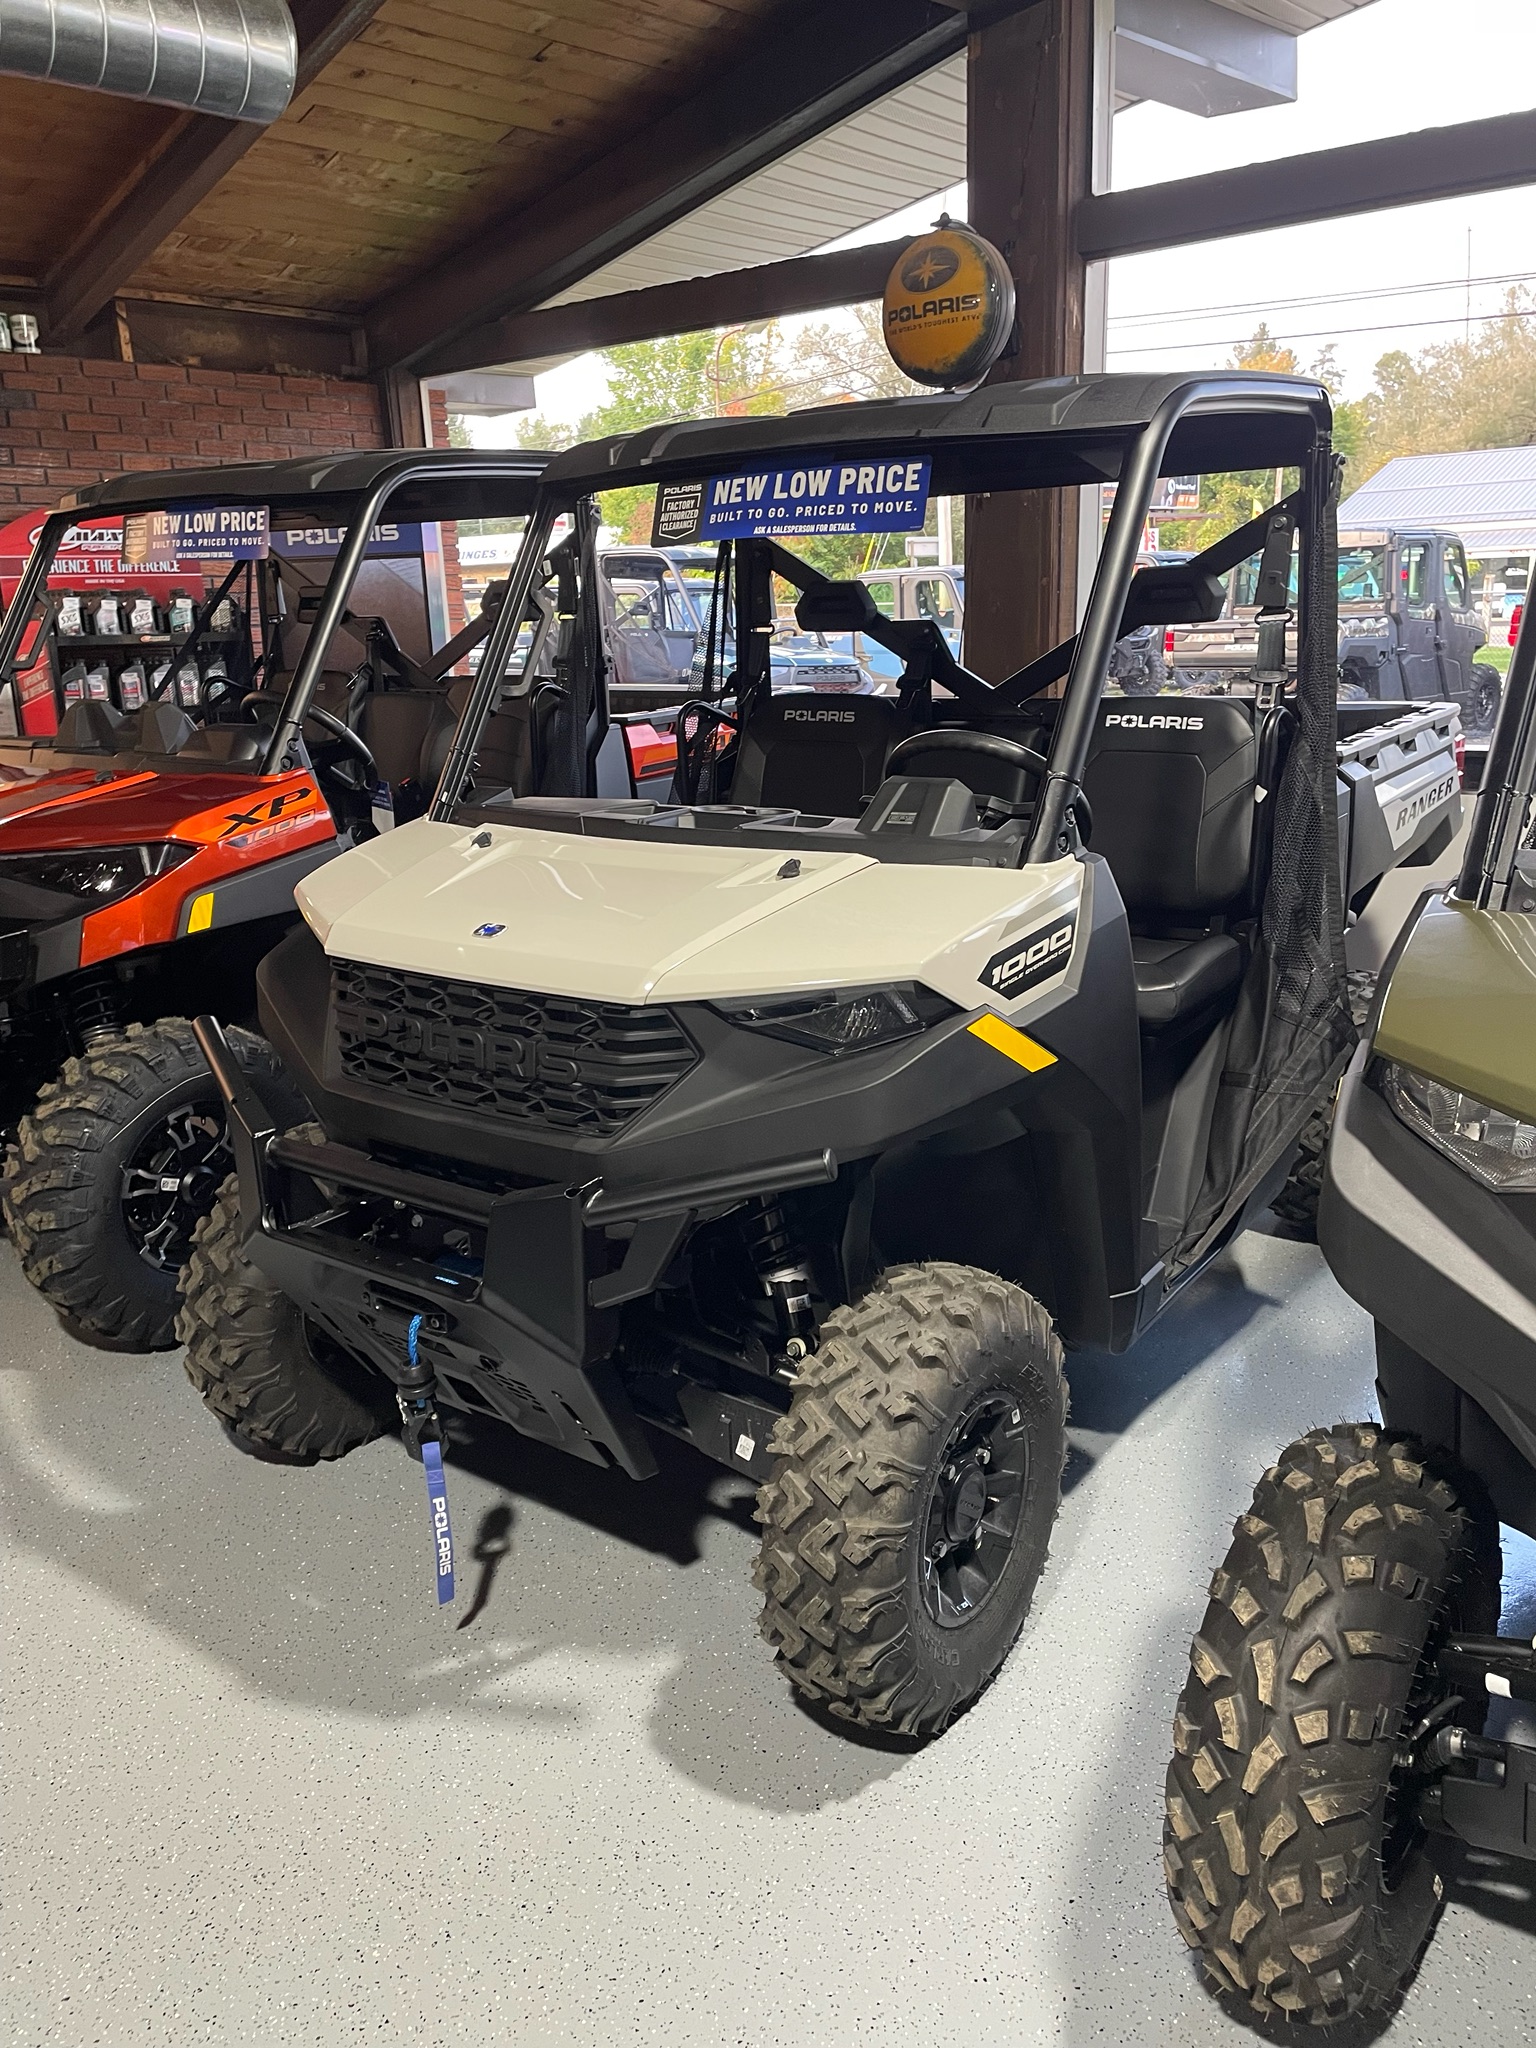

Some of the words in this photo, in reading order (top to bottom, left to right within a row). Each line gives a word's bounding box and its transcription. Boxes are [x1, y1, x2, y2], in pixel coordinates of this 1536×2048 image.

[888, 294, 980, 327] POLARIS
[924, 316, 959, 328] TOUGHEST
[664, 484, 702, 495] POLARIS
[713, 474, 768, 506] NEW
[773, 469, 833, 499] LOW
[838, 462, 923, 495] PRICE
[660, 508, 699, 522] AUTHORIZED
[667, 499, 696, 511] FACTORY
[709, 509, 742, 524] BUILT
[748, 508, 763, 519] TO
[768, 507, 789, 518] GO.
[795, 504, 845, 517] PRICED
[851, 503, 868, 515] TO
[874, 500, 917, 514] MOVE.
[152, 514, 181, 536] NEW
[184, 512, 217, 534] LOW
[220, 510, 266, 532] PRICE
[662, 519, 695, 531] CLEARANCE
[754, 526, 766, 535] ASK
[772, 524, 814, 534] SALESPERSON
[815, 524, 828, 532] FOR
[829, 523, 856, 532] DETAILS.
[152, 539, 171, 549] BUILT
[172, 539, 181, 548] TO
[182, 538, 196, 547] GO.
[198, 538, 226, 547] PRICED
[229, 537, 239, 546] TO
[241, 537, 265, 546] MOVE.
[286, 524, 400, 546] POLAIS
[94, 560, 115, 573] THE
[784, 710, 855, 722] POLARIS
[1105, 714, 1204, 730] POLARIS
[217, 787, 312, 838] XP
[1396, 776, 1453, 831] RANGER
[245, 809, 316, 845] 1000
[992, 924, 1072, 986] 1000
[1000, 972, 1024, 990] SINGLE
[358, 1005, 582, 1084] POLARIS
[432, 1497, 452, 1576] POLARIS
